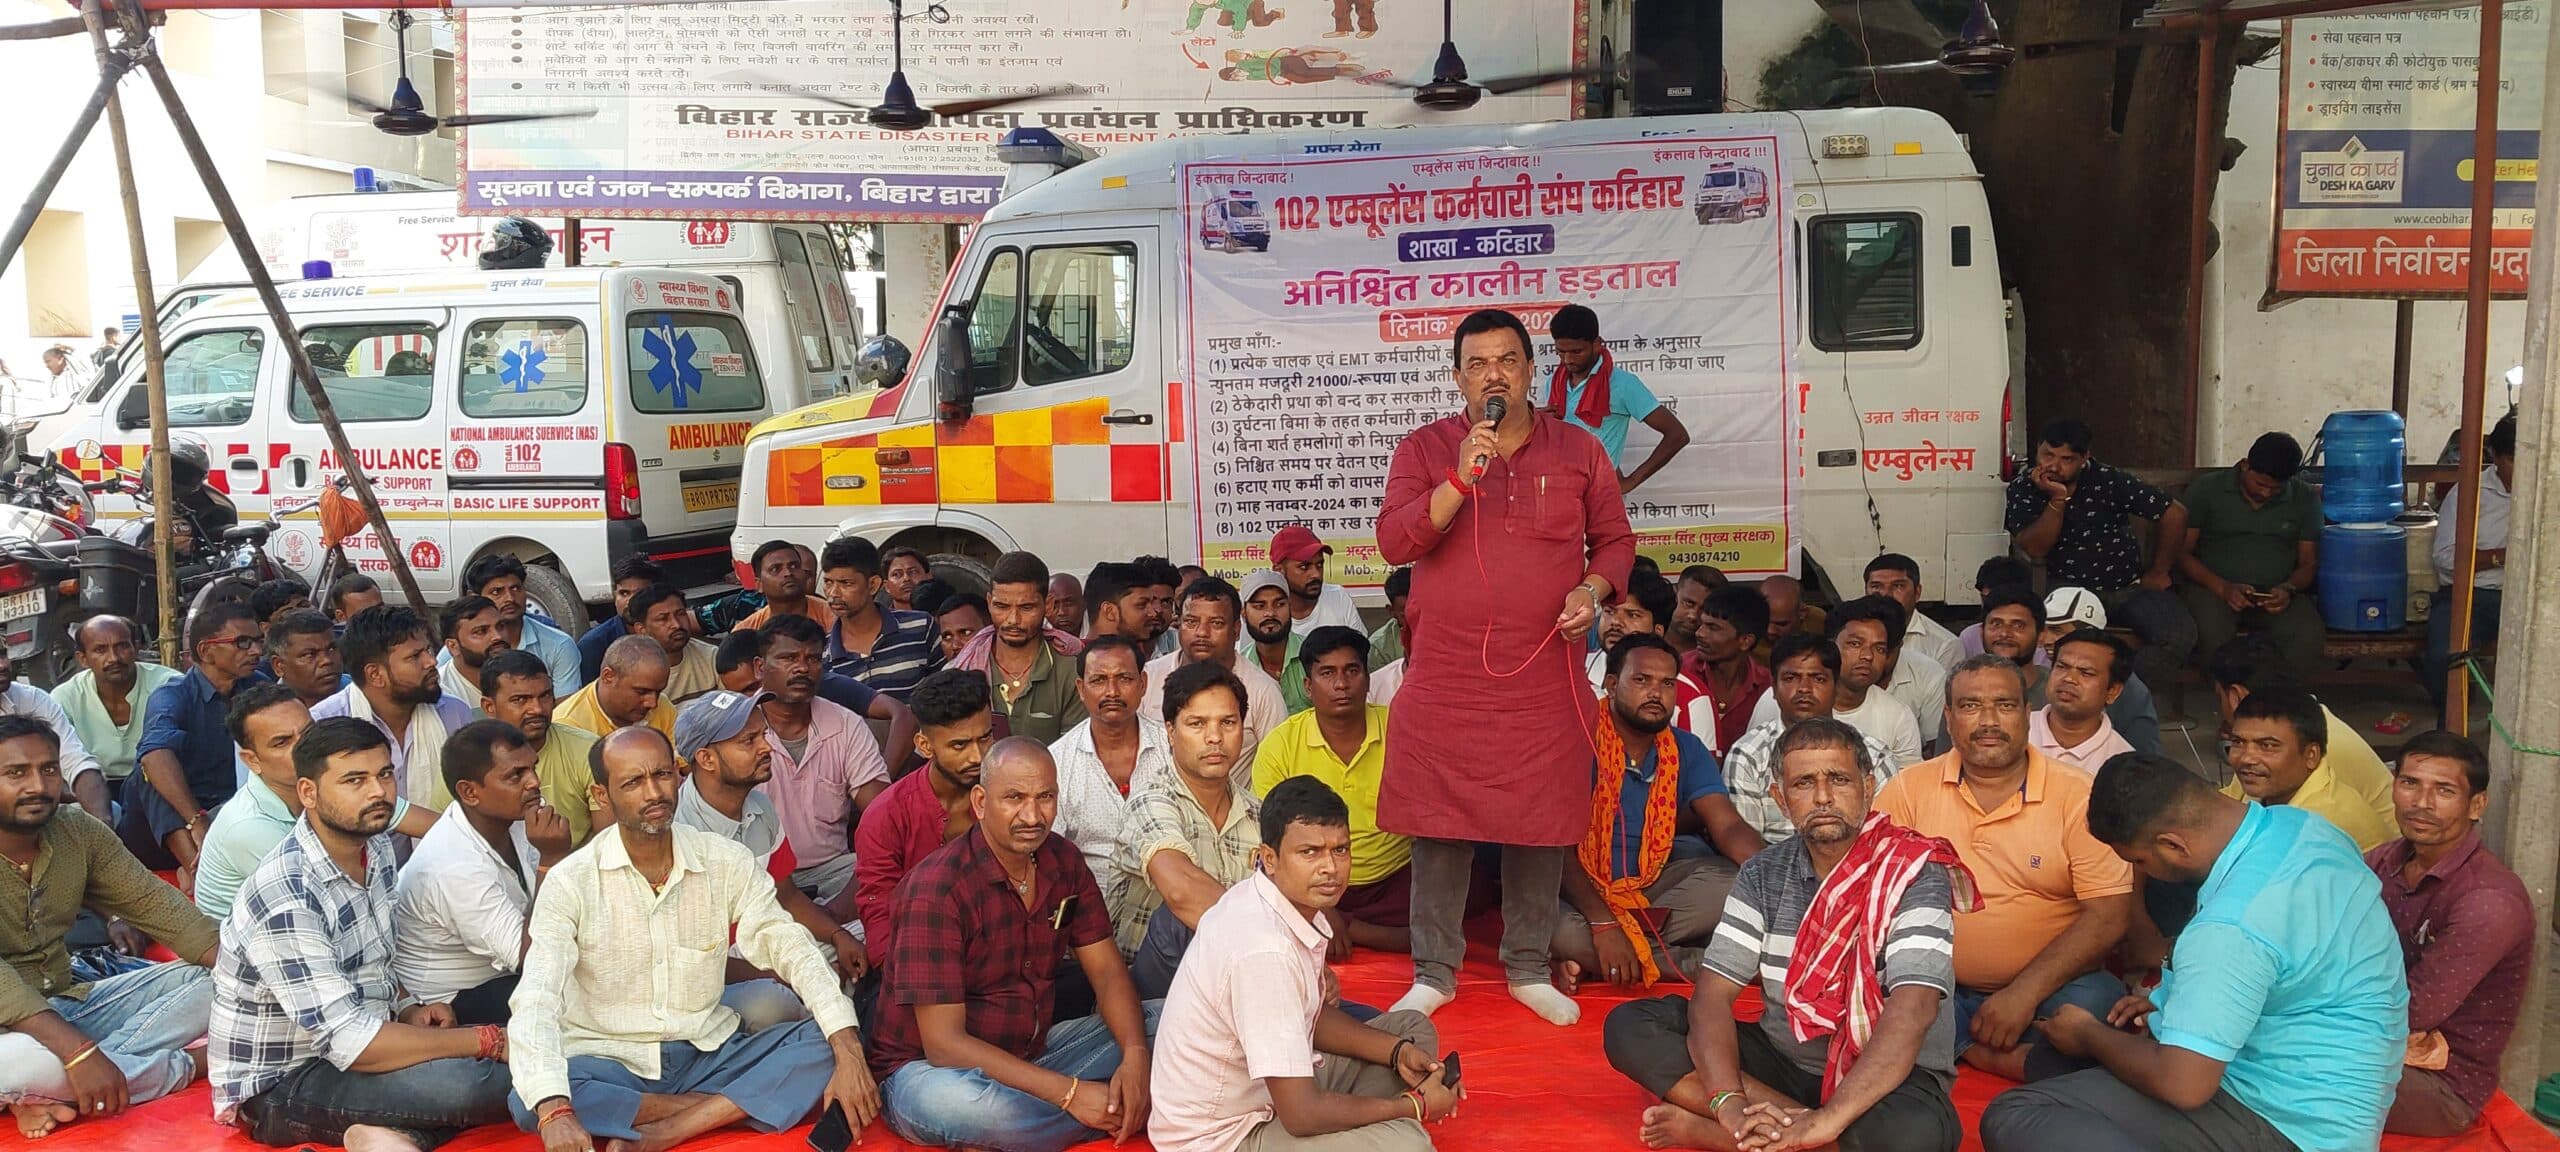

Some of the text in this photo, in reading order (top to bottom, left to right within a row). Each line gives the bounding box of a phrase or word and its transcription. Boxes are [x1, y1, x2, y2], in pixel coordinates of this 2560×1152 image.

[973, 30, 996, 38] आग
[2323, 30, 2401, 44] सेवा पहचान पत्र
[2385, 52, 2399, 67] की
[2388, 76, 2413, 91] स्मार्ट
[2417, 76, 2441, 91] कार्ड
[675, 104, 778, 125] बिहार
[1037, 105, 1160, 129] प्रबंधन
[1175, 107, 1368, 128] प्राधिकरण
[726, 129, 793, 139] BIHAR
[801, 130, 875, 140] STATE
[880, 131, 990, 142] DISASTER
[1457, 158, 1475, 171] संघ
[2304, 157, 2399, 183] चुनाव का पर्व
[477, 180, 553, 206] सूचना
[557, 175, 595, 200] एवं
[758, 177, 852, 202] विभाग,
[860, 178, 936, 203] बिहार
[939, 185, 992, 205] द्वारा
[2320, 181, 2395, 191] DESH KA GARV
[1275, 196, 1320, 230] 102
[1431, 172, 1534, 222] कर्मचारी
[1538, 173, 1585, 216] संघ
[1589, 168, 1685, 212] कटिहार
[398, 215, 455, 225] Free Service
[1408, 231, 1543, 258] शाखा कटिहार
[2294, 236, 2366, 277] जिला
[521, 278, 544, 288] सेवा
[1284, 260, 1681, 307] अनिश्चित कालीन हड़ताल
[302, 286, 365, 298] SERVICE
[1208, 337, 1242, 353] प्रमुख
[1209, 359, 1226, 374] (1)
[1230, 354, 1267, 371] प्रत्येक
[1272, 354, 1311, 369] चालक
[1316, 351, 1334, 369] एवं
[1340, 353, 1370, 366] EMT
[1375, 344, 1441, 364] कर्मचारीयों
[1634, 334, 1647, 350] के
[1653, 335, 1702, 352] अनुसार
[1259, 373, 1303, 393] मजदूरी
[1401, 367, 1419, 385] एवं
[1659, 354, 1693, 371] किया
[1697, 355, 1725, 370] जाए
[1210, 398, 1228, 413] (2)
[1232, 394, 1282, 412] ठेकेदारी
[1287, 395, 1310, 409] प्रथा
[1315, 391, 1333, 408] को
[1367, 393, 1386, 406] कर
[1391, 387, 1442, 404] सरकारी
[1211, 420, 1229, 435] (3)
[1314, 412, 1327, 429] के
[1332, 415, 1359, 429] तहत
[1364, 410, 1416, 426] कर्मचारी
[1420, 407, 1437, 424] को
[1863, 408, 1980, 424] उन्नत जीवन रक्षक
[450, 426, 598, 441] NATIONAL AMBULANCE SUERVICE (NAS)
[505, 444, 513, 461] CALL
[514, 444, 541, 461] 102
[1212, 440, 1229, 456] (4)
[1234, 436, 1262, 453] बिना
[1266, 435, 1289, 451] शर्त
[1293, 432, 1344, 451] हमलोगों
[1348, 432, 1365, 448] को
[1213, 452, 1388, 477] (5) निश्चित समय पर वेतन एवं
[1863, 440, 1976, 481] एम्बुलेन्स
[384, 477, 433, 491] SUPPORT
[1214, 473, 1384, 497] (6) हटाए गए कर्मी को वापस
[394, 496, 443, 511] एम्बुलेन्स
[454, 498, 600, 508] BASIC LIFE SUPPORT
[1215, 502, 1233, 516] (7)
[1236, 500, 1261, 514] माह
[1265, 497, 1346, 512] नवम्बर-2024
[1350, 497, 1367, 509] का
[1643, 502, 1677, 518] किया
[1216, 521, 1234, 537] (8)
[1238, 520, 1262, 534] 102
[1319, 517, 1335, 530] का
[1340, 517, 1361, 530] रख
[1675, 529, 1696, 545] सिंह
[1700, 532, 1729, 547] (मुख्य
[1220, 544, 1265, 561] अमर सिंह
[1668, 551, 1740, 564] 9430874210
